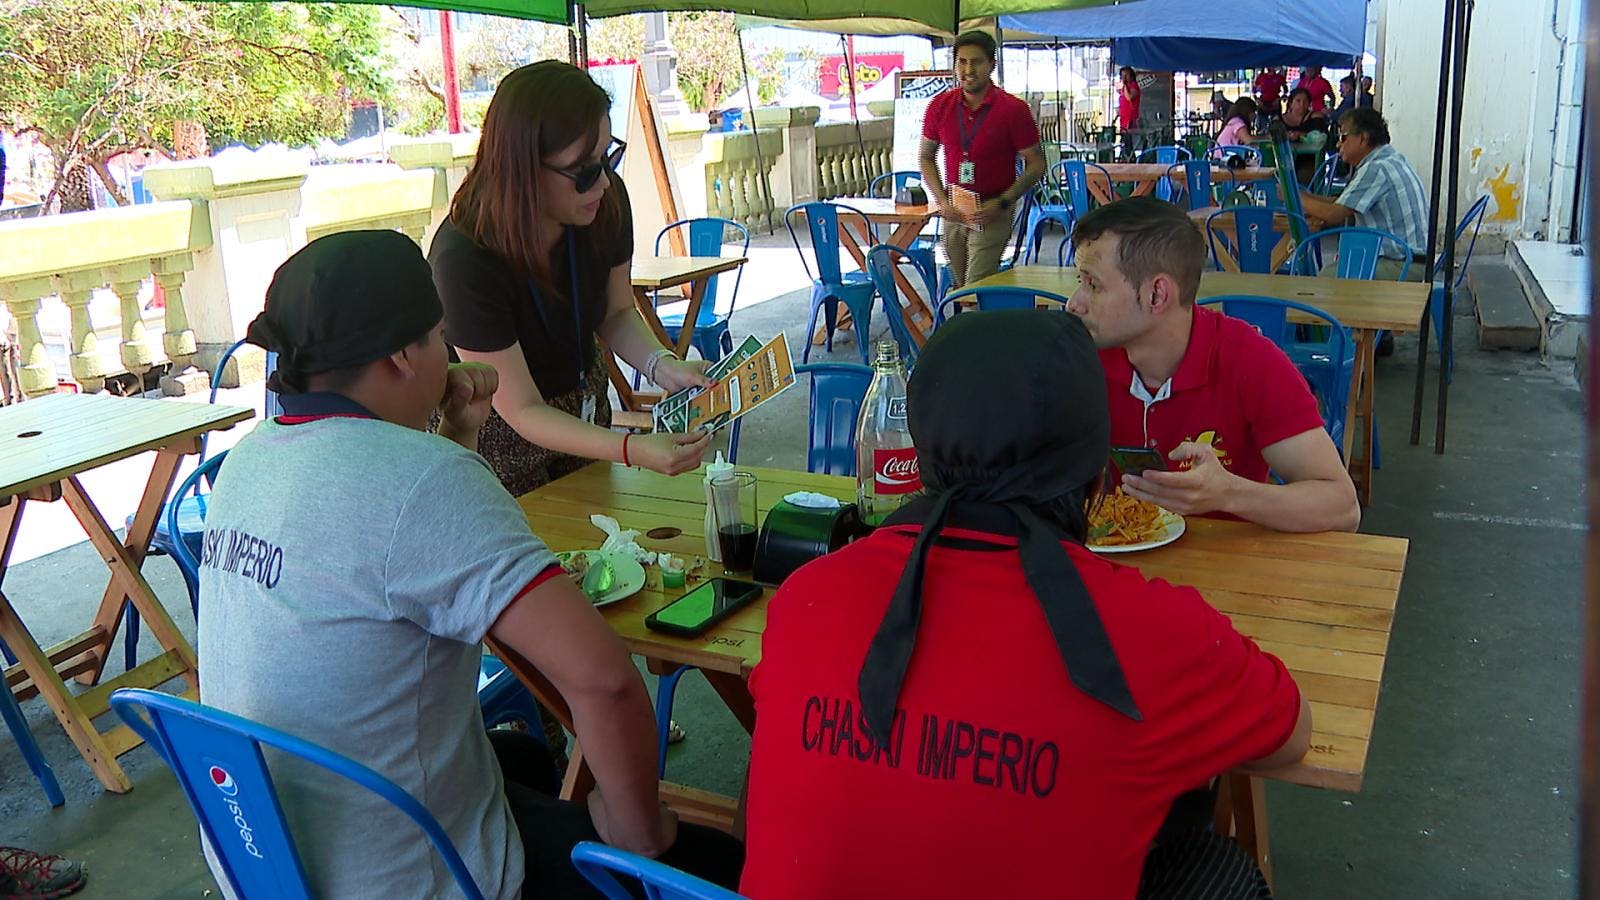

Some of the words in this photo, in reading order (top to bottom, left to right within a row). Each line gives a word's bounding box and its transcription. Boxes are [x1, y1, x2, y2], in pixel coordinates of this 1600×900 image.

[902, 79, 945, 99] CRISTAL
[202, 528, 226, 570] SKI
[222, 528, 284, 590] IMPERIO
[916, 713, 1060, 799] IMPERIO
[222, 797, 264, 860] pepsi
